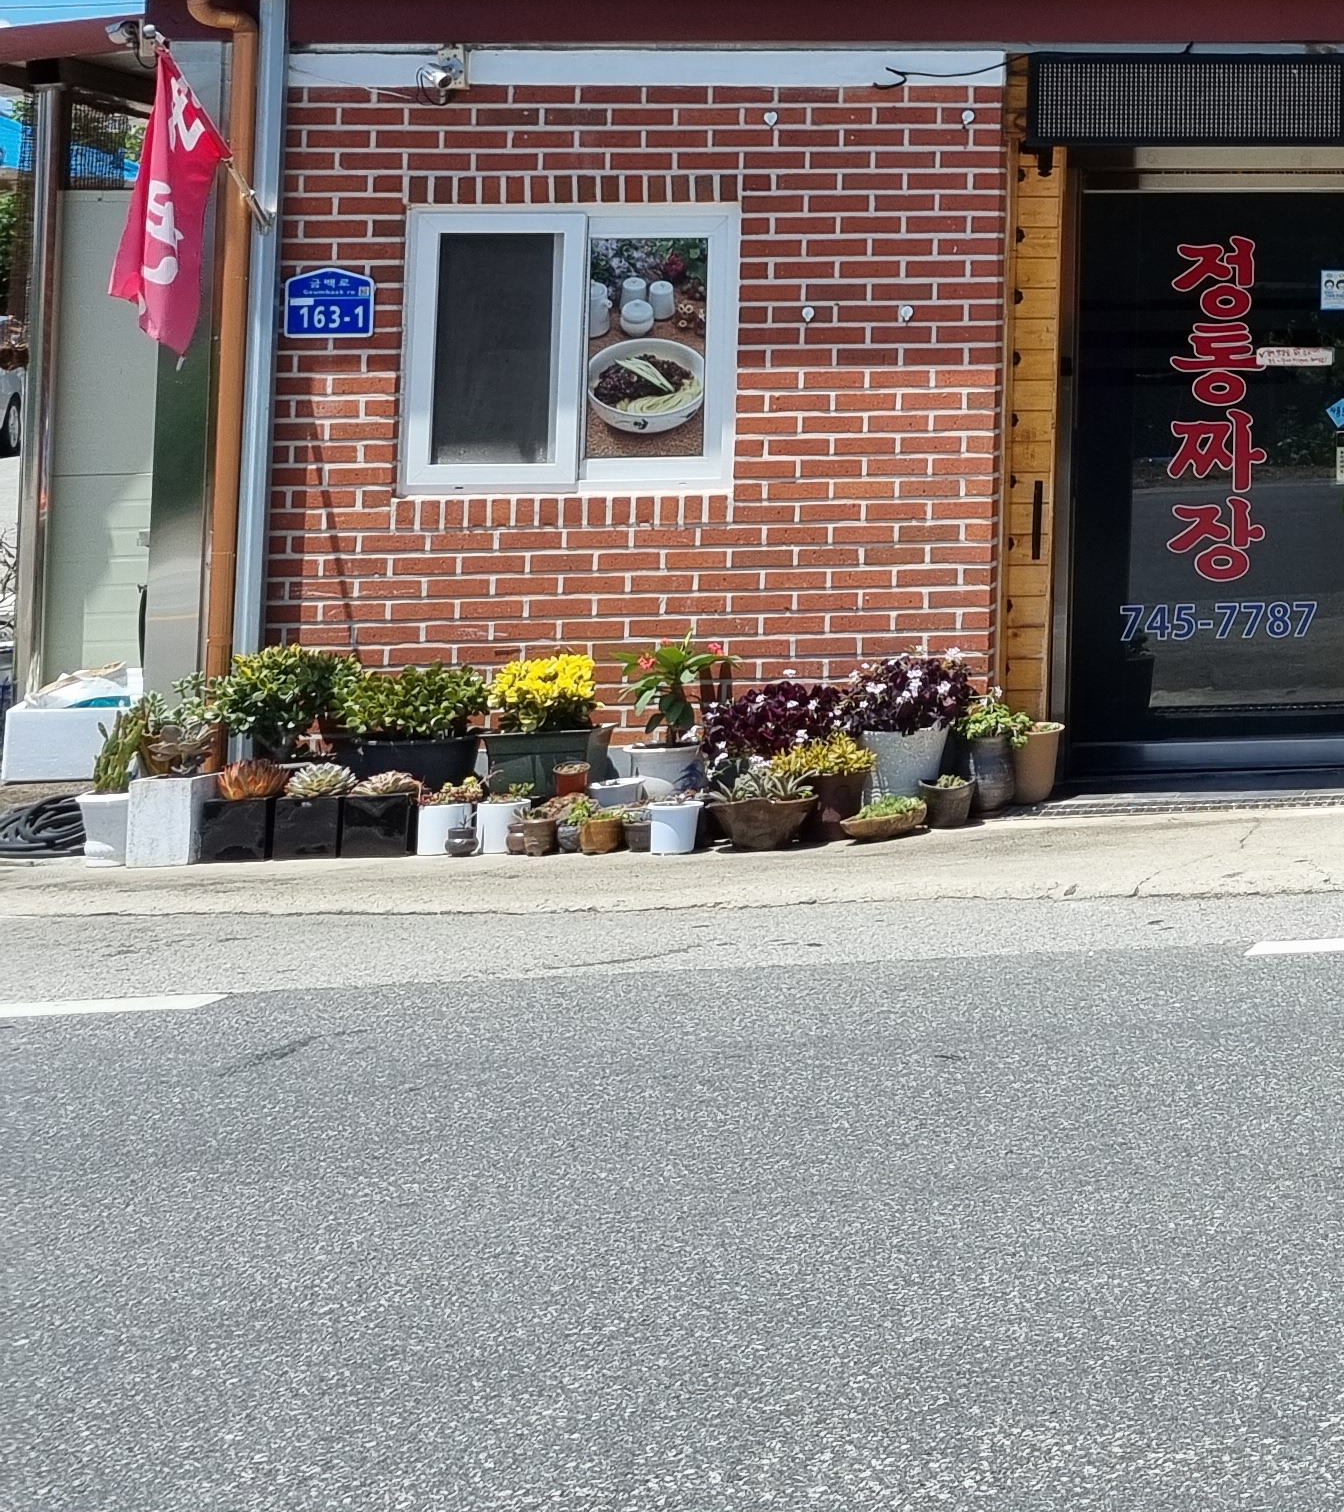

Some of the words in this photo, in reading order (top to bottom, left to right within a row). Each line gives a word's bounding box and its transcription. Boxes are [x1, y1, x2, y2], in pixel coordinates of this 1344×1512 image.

[300, 305, 364, 328] 163-1
[1166, 235, 1267, 583] 정통짜장
[1120, 600, 1318, 643] 745-7787
